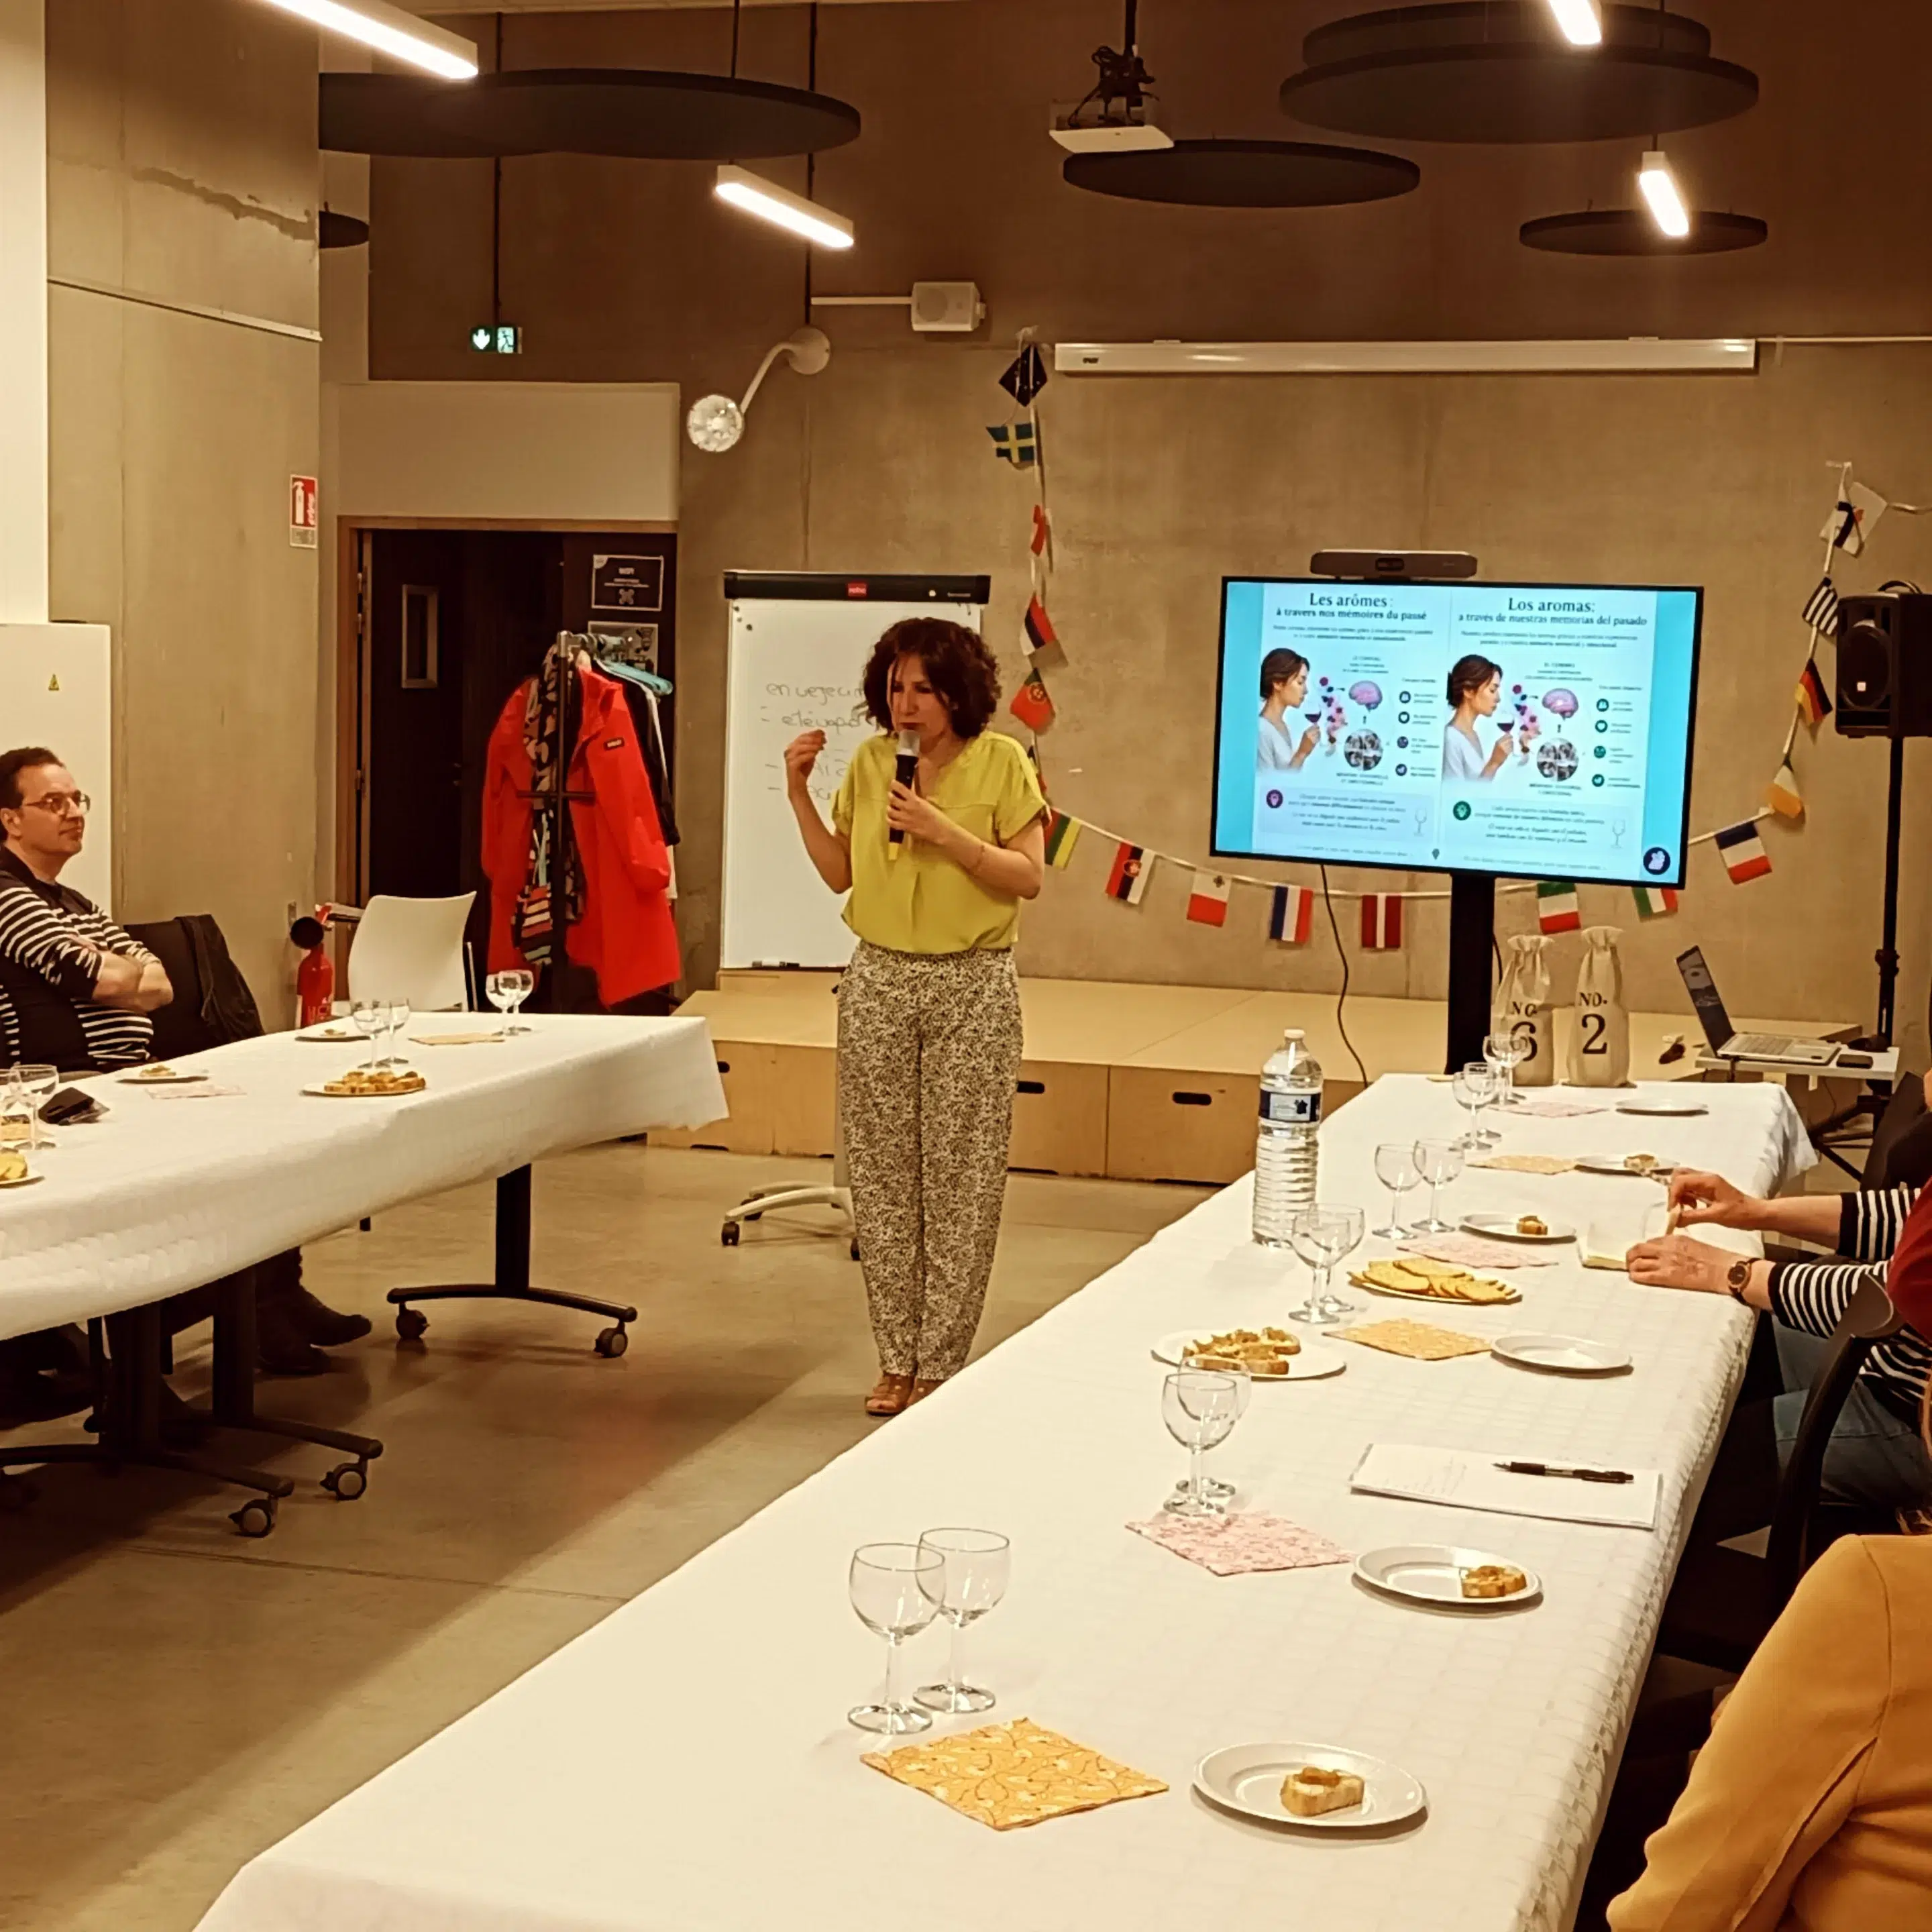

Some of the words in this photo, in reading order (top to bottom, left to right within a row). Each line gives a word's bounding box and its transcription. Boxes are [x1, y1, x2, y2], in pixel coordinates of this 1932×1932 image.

[1310, 592, 1332, 606] Les
[1509, 597, 1534, 611] Los
[1538, 601, 1596, 612] aromas:
[1284, 609, 1316, 617] travers
[1387, 610, 1399, 619] du
[1496, 613, 1506, 623] de
[1509, 615, 1547, 623] nuestras
[1597, 615, 1611, 625] del
[1613, 616, 1648, 627] pasado
[1578, 992, 1608, 1007] NO.
[1510, 1021, 1538, 1061] 6
[1581, 1014, 1608, 1055] 2
